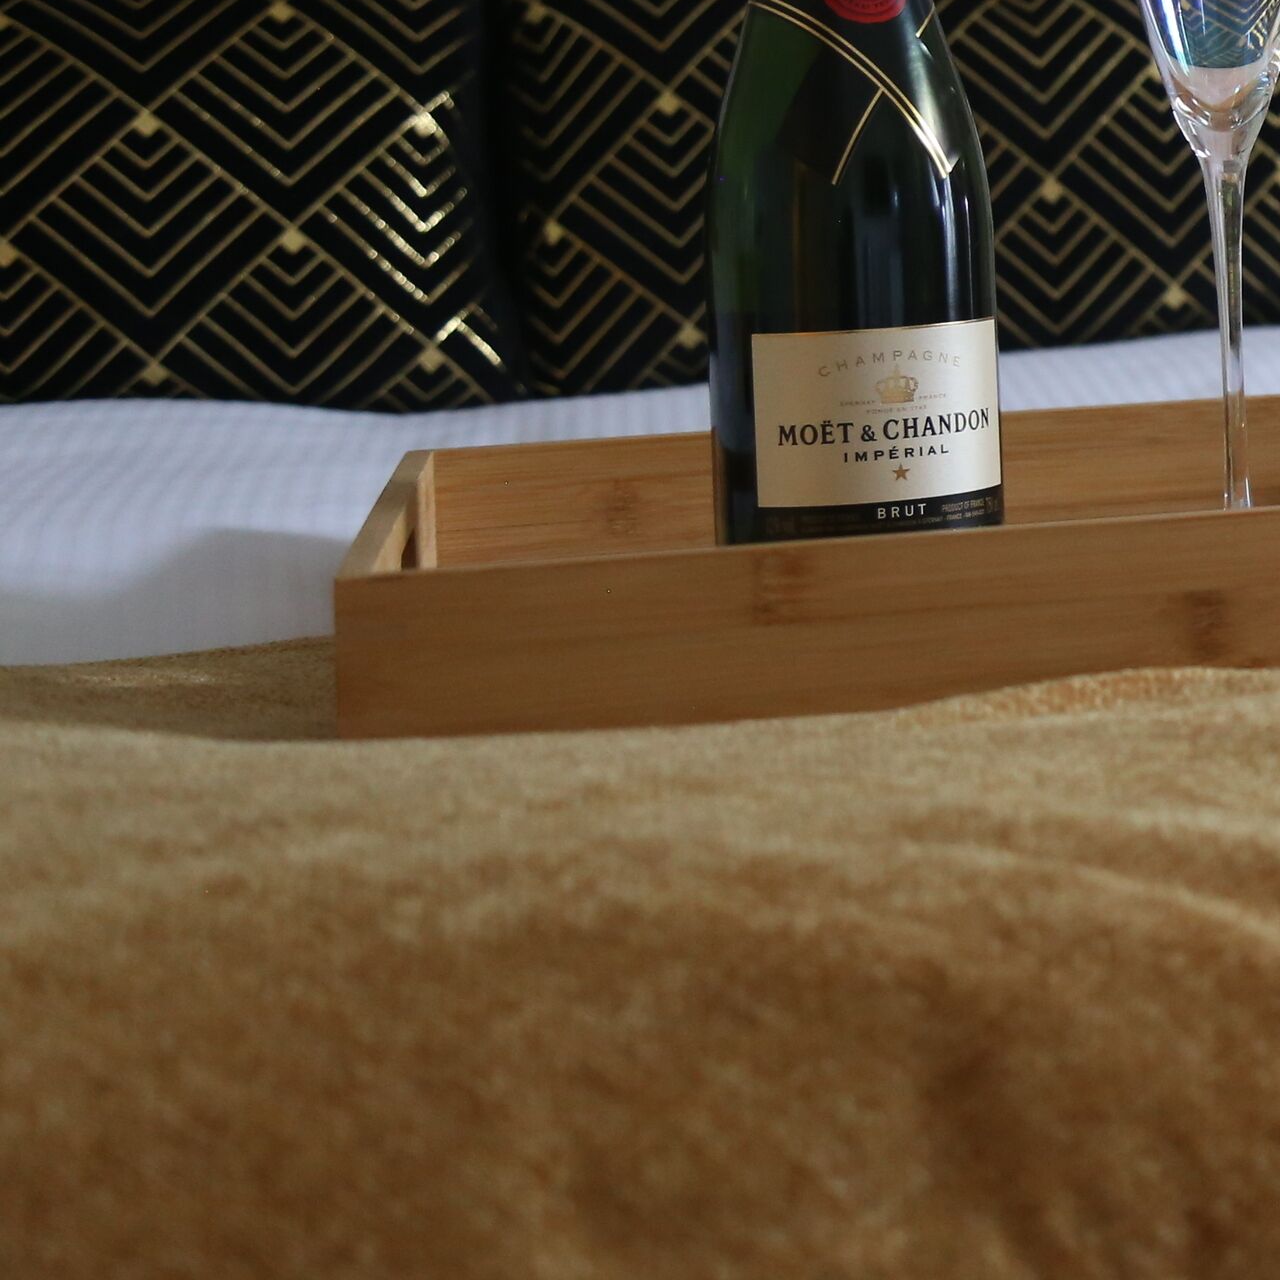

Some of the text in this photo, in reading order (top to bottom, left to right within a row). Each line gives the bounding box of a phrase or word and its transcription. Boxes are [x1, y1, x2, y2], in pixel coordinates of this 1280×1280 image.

[818, 349, 961, 377] CHAMPAGNE
[778, 407, 990, 446] MOËT & CHANDON
[844, 442, 949, 463] IMPÉRIAL
[877, 503, 927, 519] BRUT
